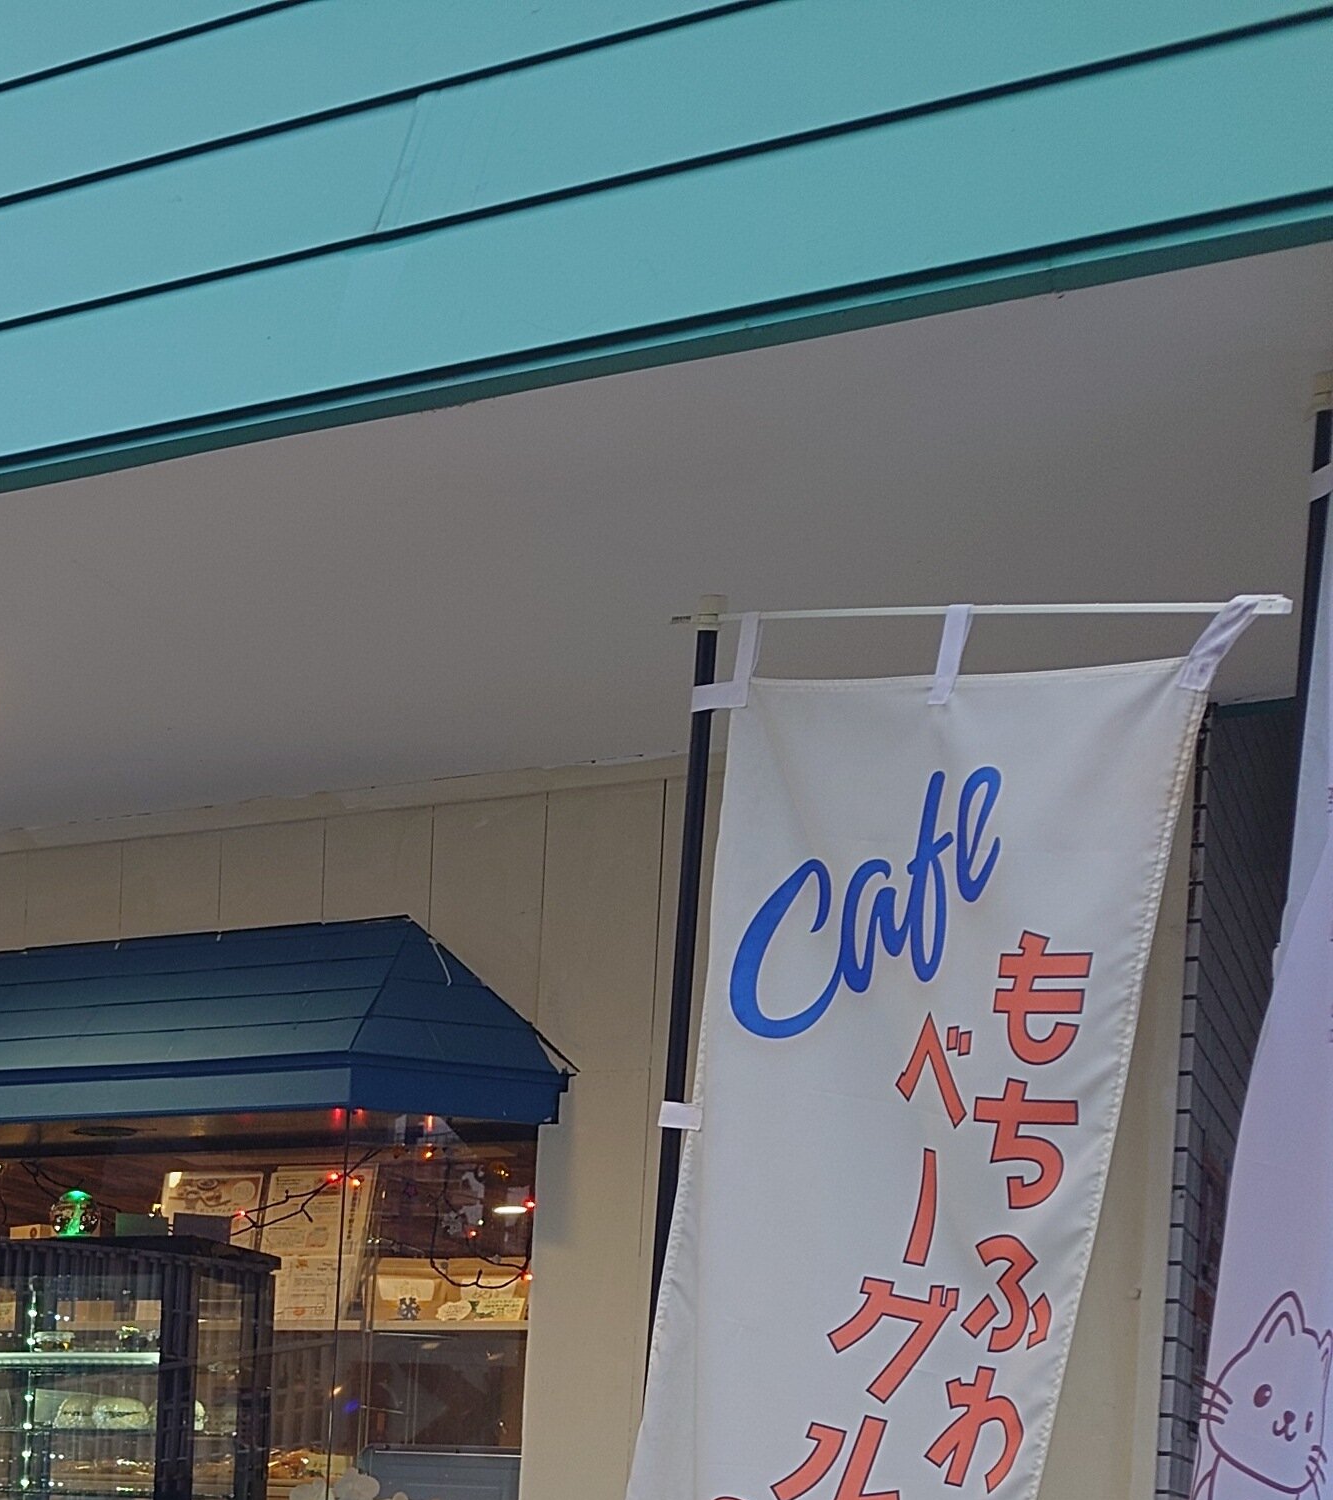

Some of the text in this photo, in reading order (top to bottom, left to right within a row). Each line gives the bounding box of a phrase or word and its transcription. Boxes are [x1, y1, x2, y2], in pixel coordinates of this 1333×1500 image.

[728, 766, 1002, 1040] Cafe
[925, 931, 1093, 1495] もちふわ
